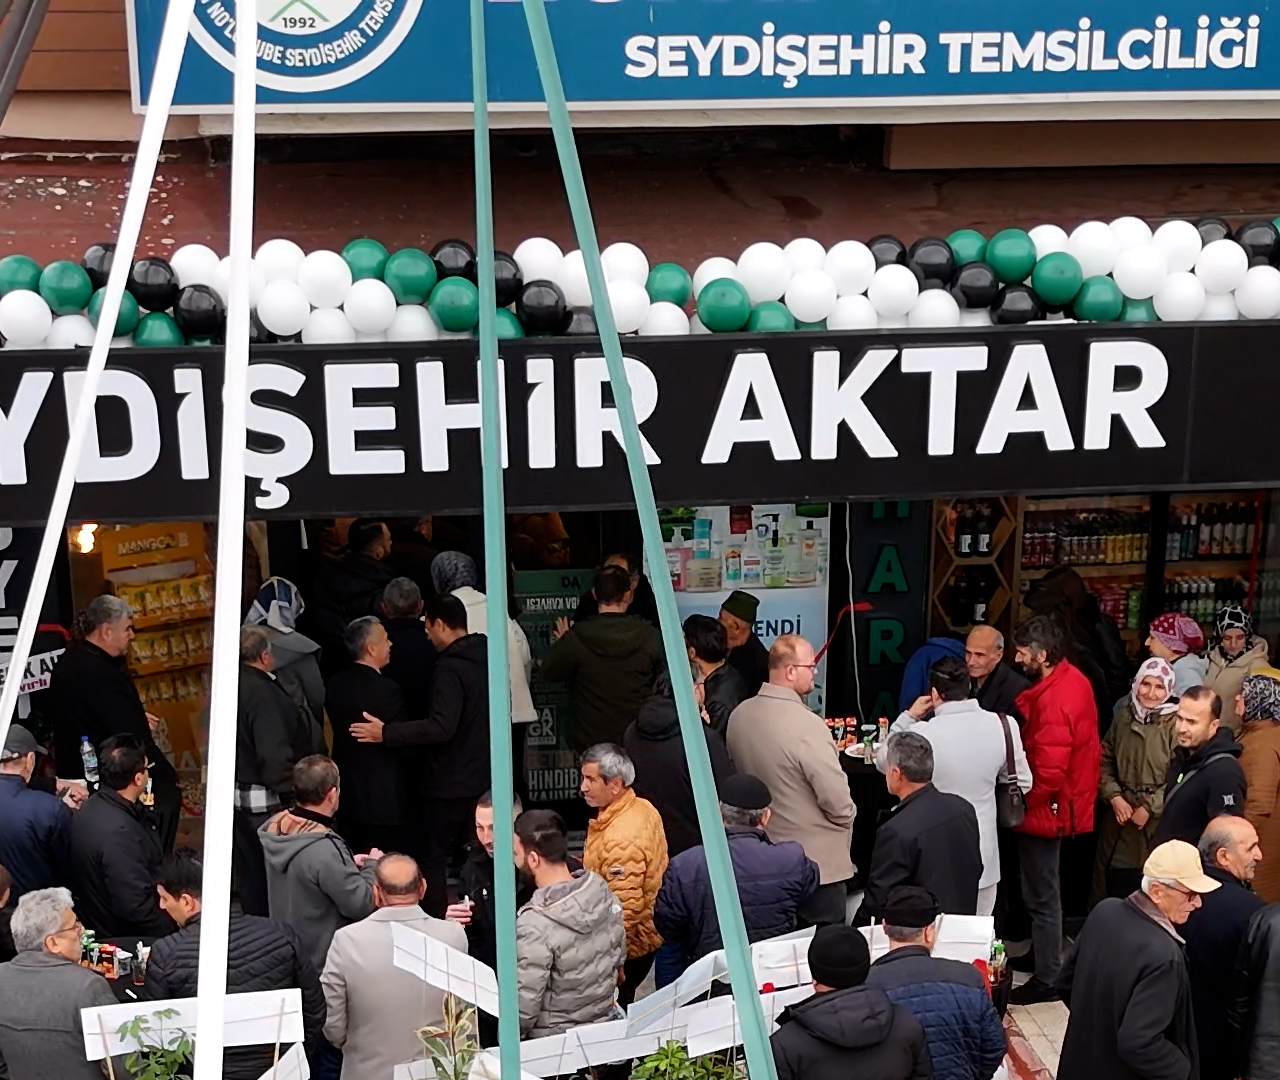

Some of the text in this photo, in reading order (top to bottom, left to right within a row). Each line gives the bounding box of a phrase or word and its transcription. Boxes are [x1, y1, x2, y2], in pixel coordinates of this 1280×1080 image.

[256, 38, 284, 65] UBE
[285, 29, 367, 68] SEYDİŞEHİR
[283, 17, 317, 29] 1992
[623, 15, 1260, 88] SEYDİŞEHİR TEMSİLCİLİĞİ
[700, 340, 1171, 467] AKTAR
